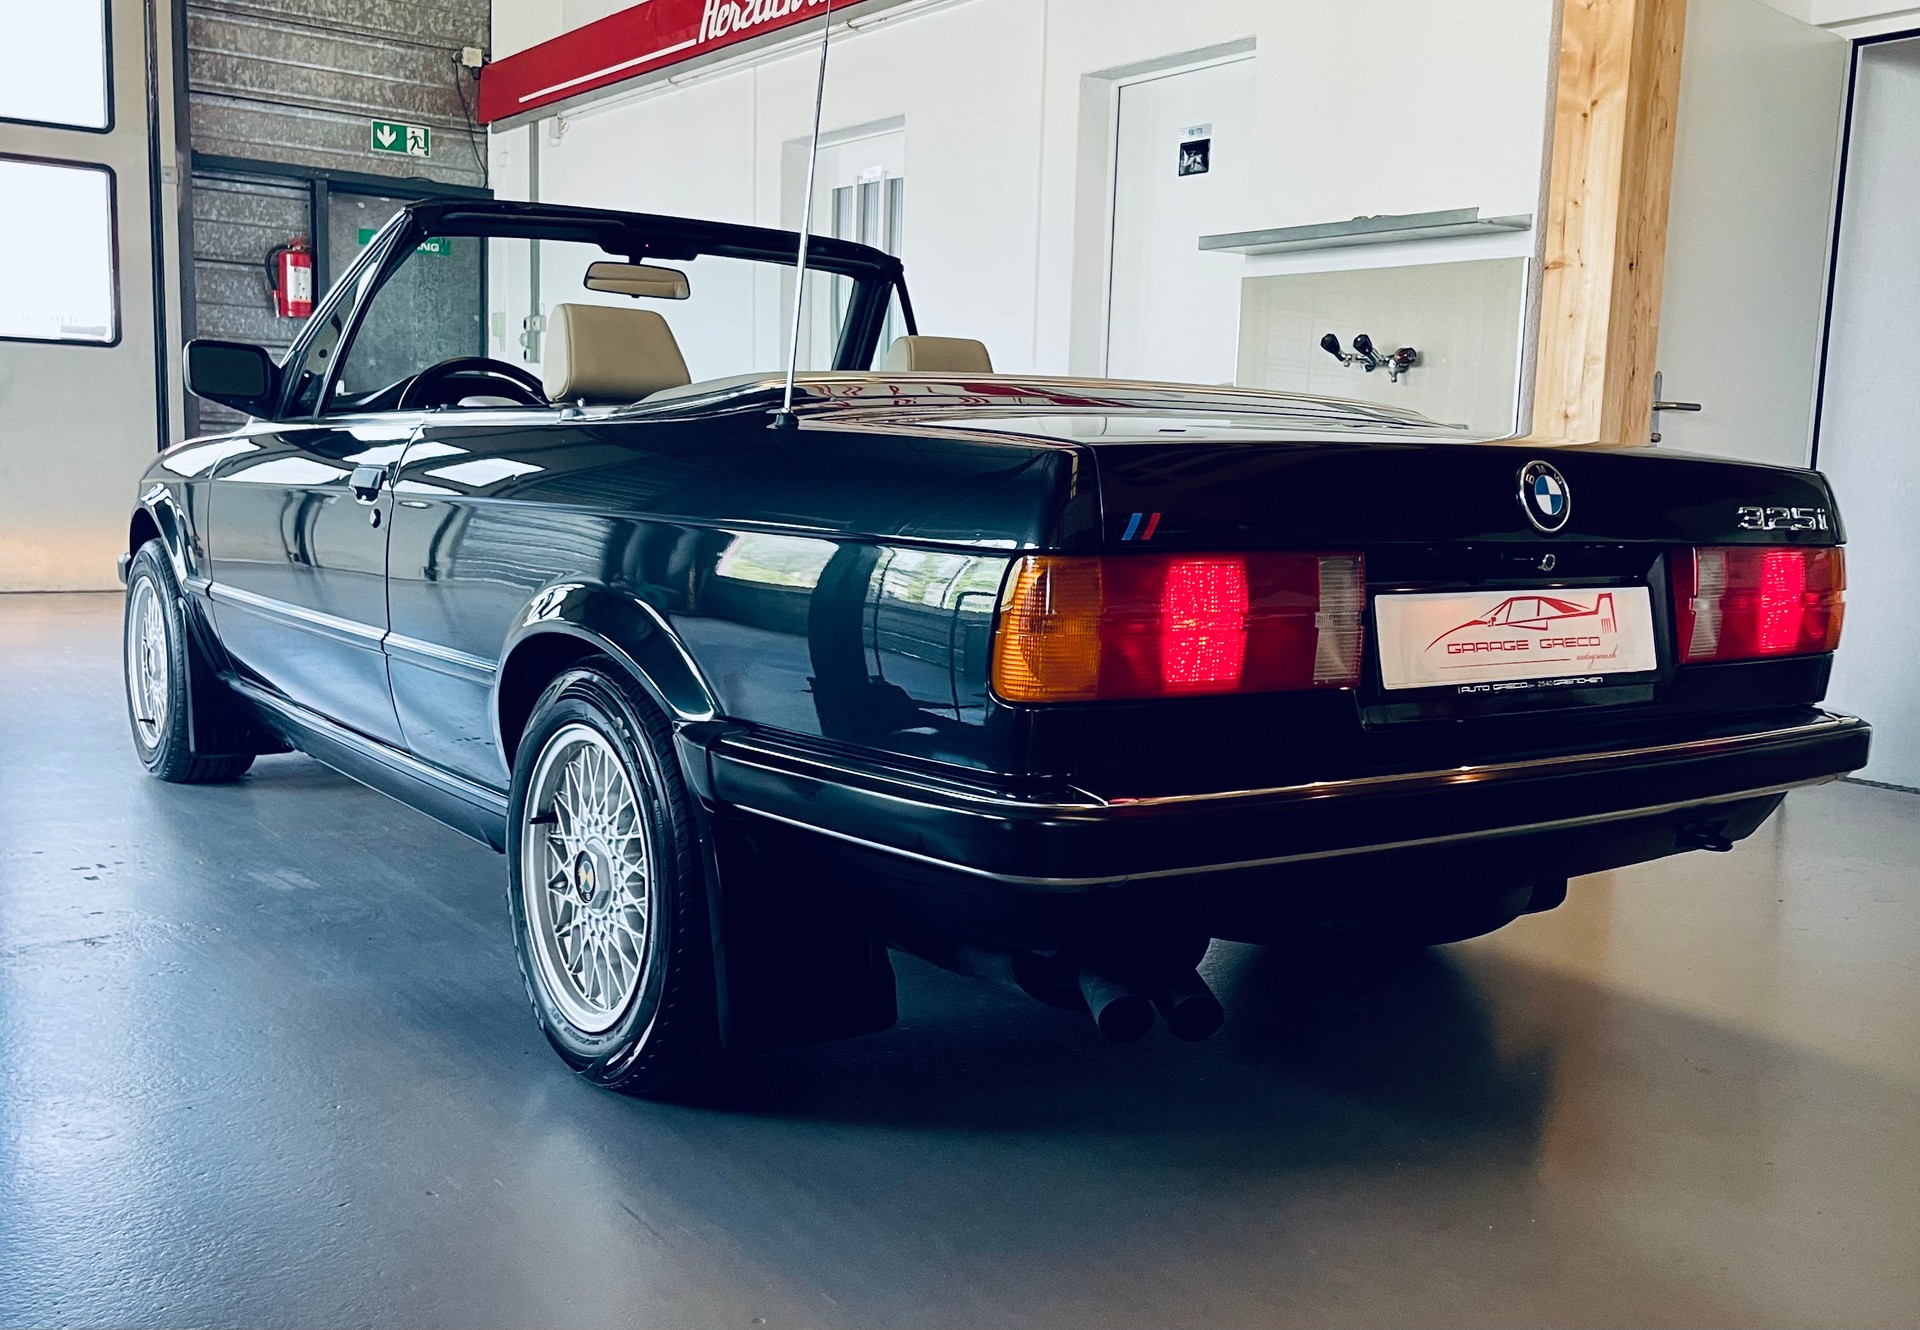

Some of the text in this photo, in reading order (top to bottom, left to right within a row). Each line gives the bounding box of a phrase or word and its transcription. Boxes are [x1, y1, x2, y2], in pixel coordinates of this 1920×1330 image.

[1525, 465, 1562, 485] BMW
[1736, 506, 1828, 530] 325i
[1447, 636, 1601, 654] GARAGE GRECO
[1461, 685, 1490, 693] AUTO
[1493, 682, 1528, 691] GRECO
